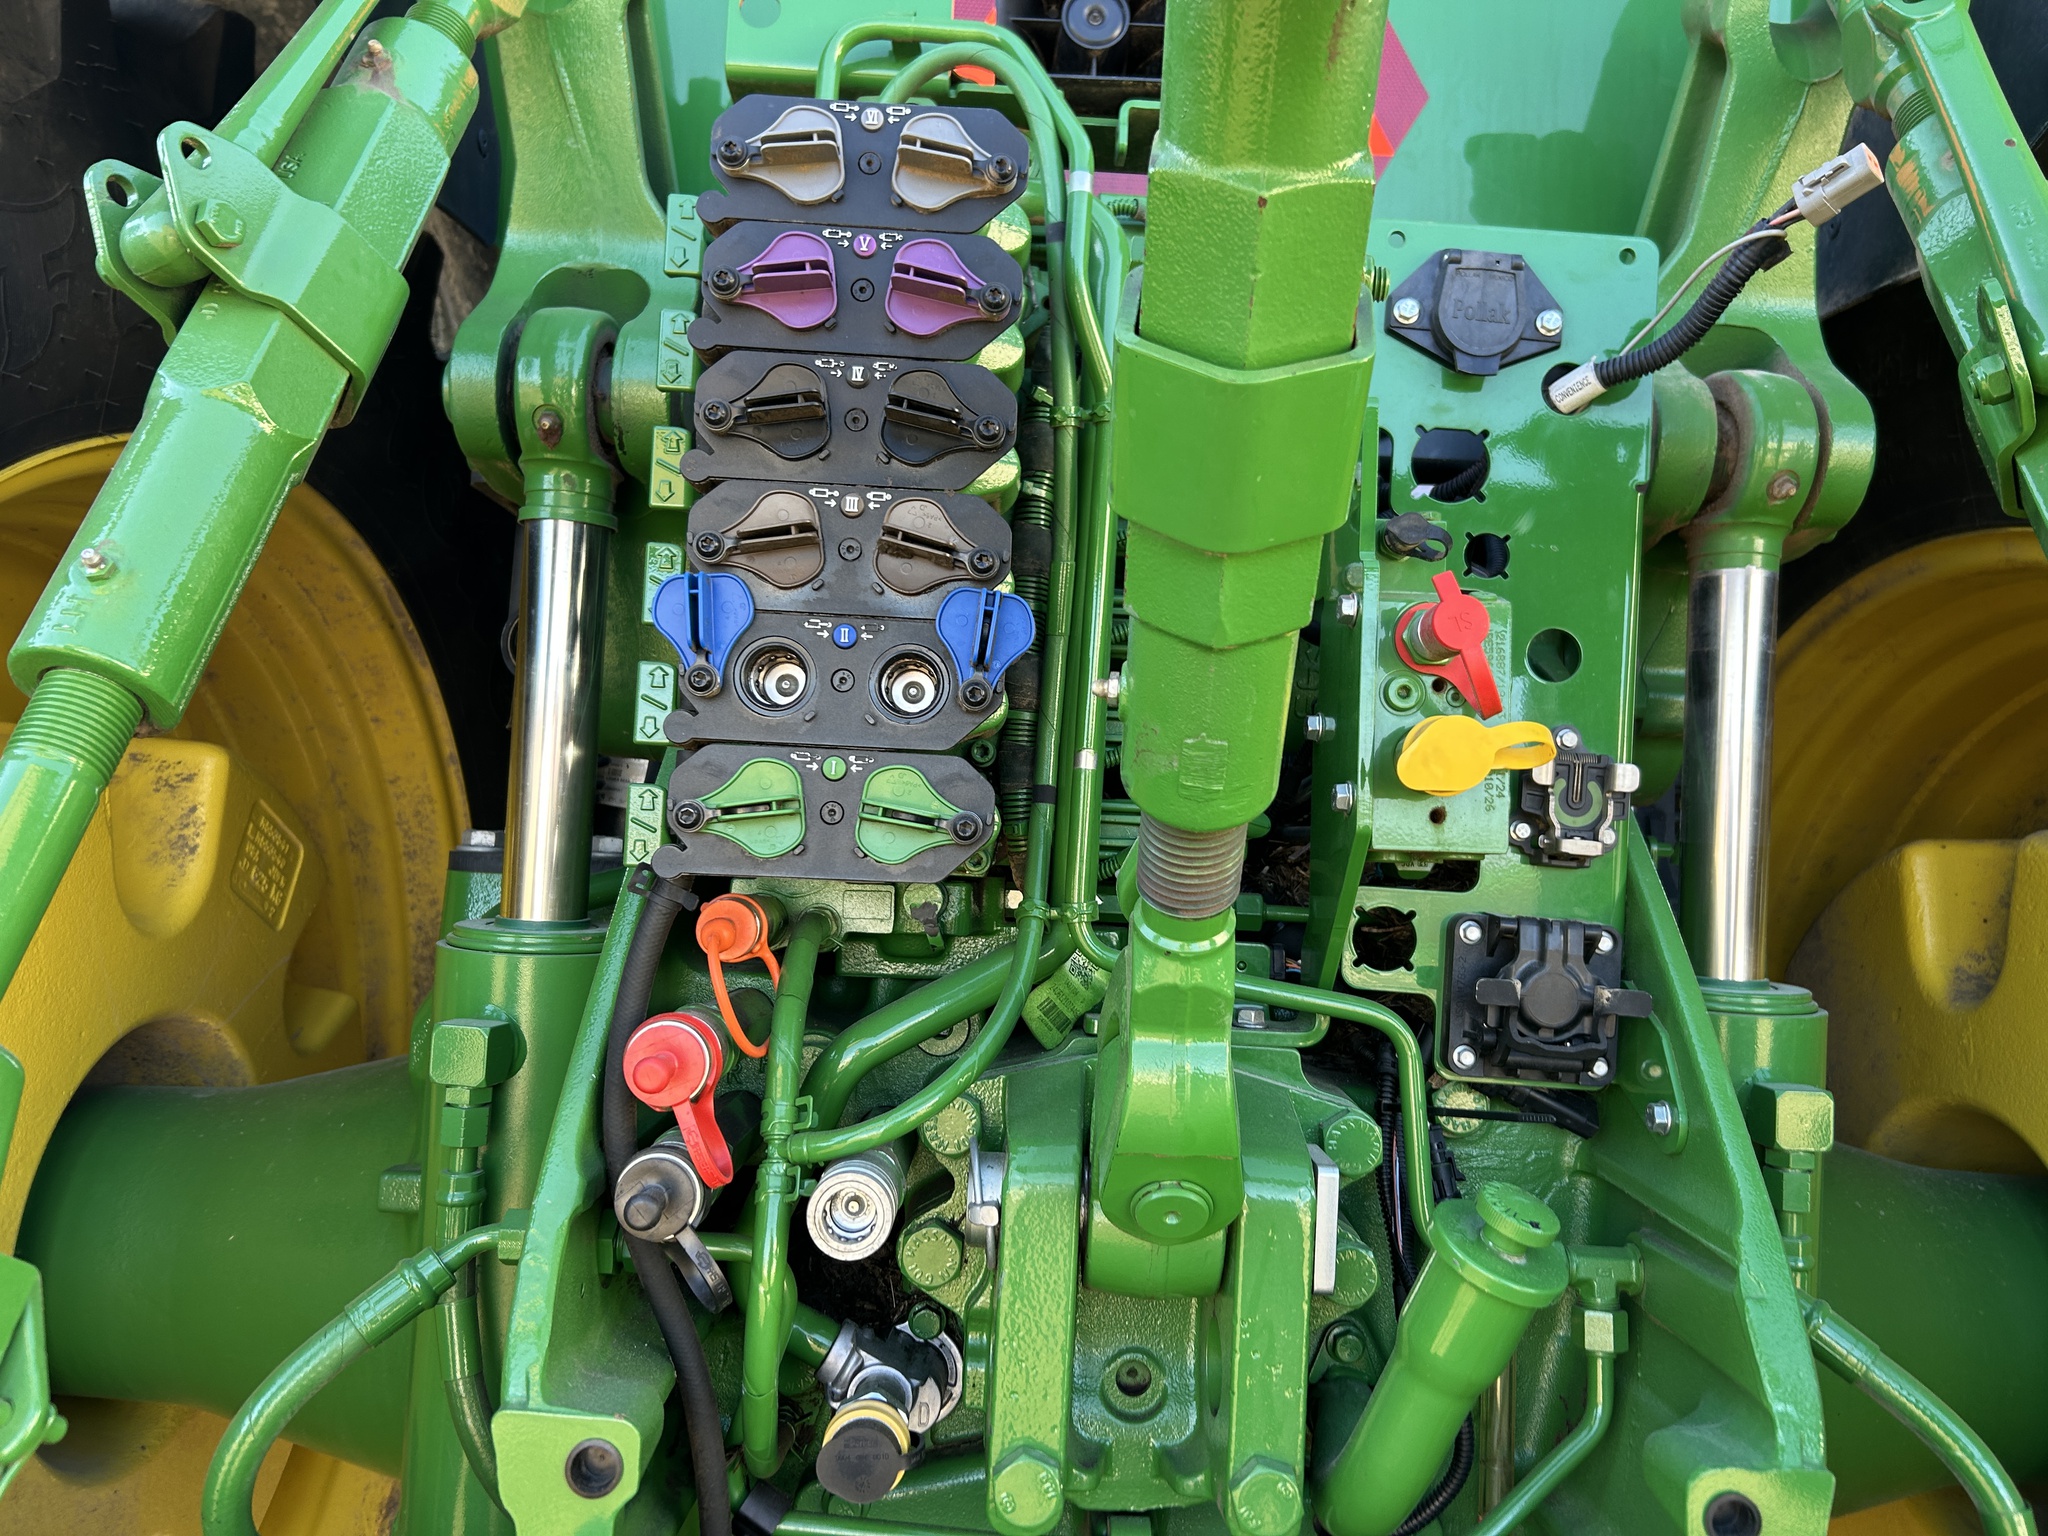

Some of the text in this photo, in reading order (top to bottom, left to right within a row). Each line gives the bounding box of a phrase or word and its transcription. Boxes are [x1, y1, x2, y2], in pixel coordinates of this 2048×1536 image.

[865, 108, 879, 125] VI
[858, 236, 871, 252] V
[1452, 299, 1511, 325] Pollak
[851, 365, 865, 382] IV
[1555, 375, 1592, 404] CONVENIENCE
[844, 496, 859, 513] III
[839, 627, 850, 643] II
